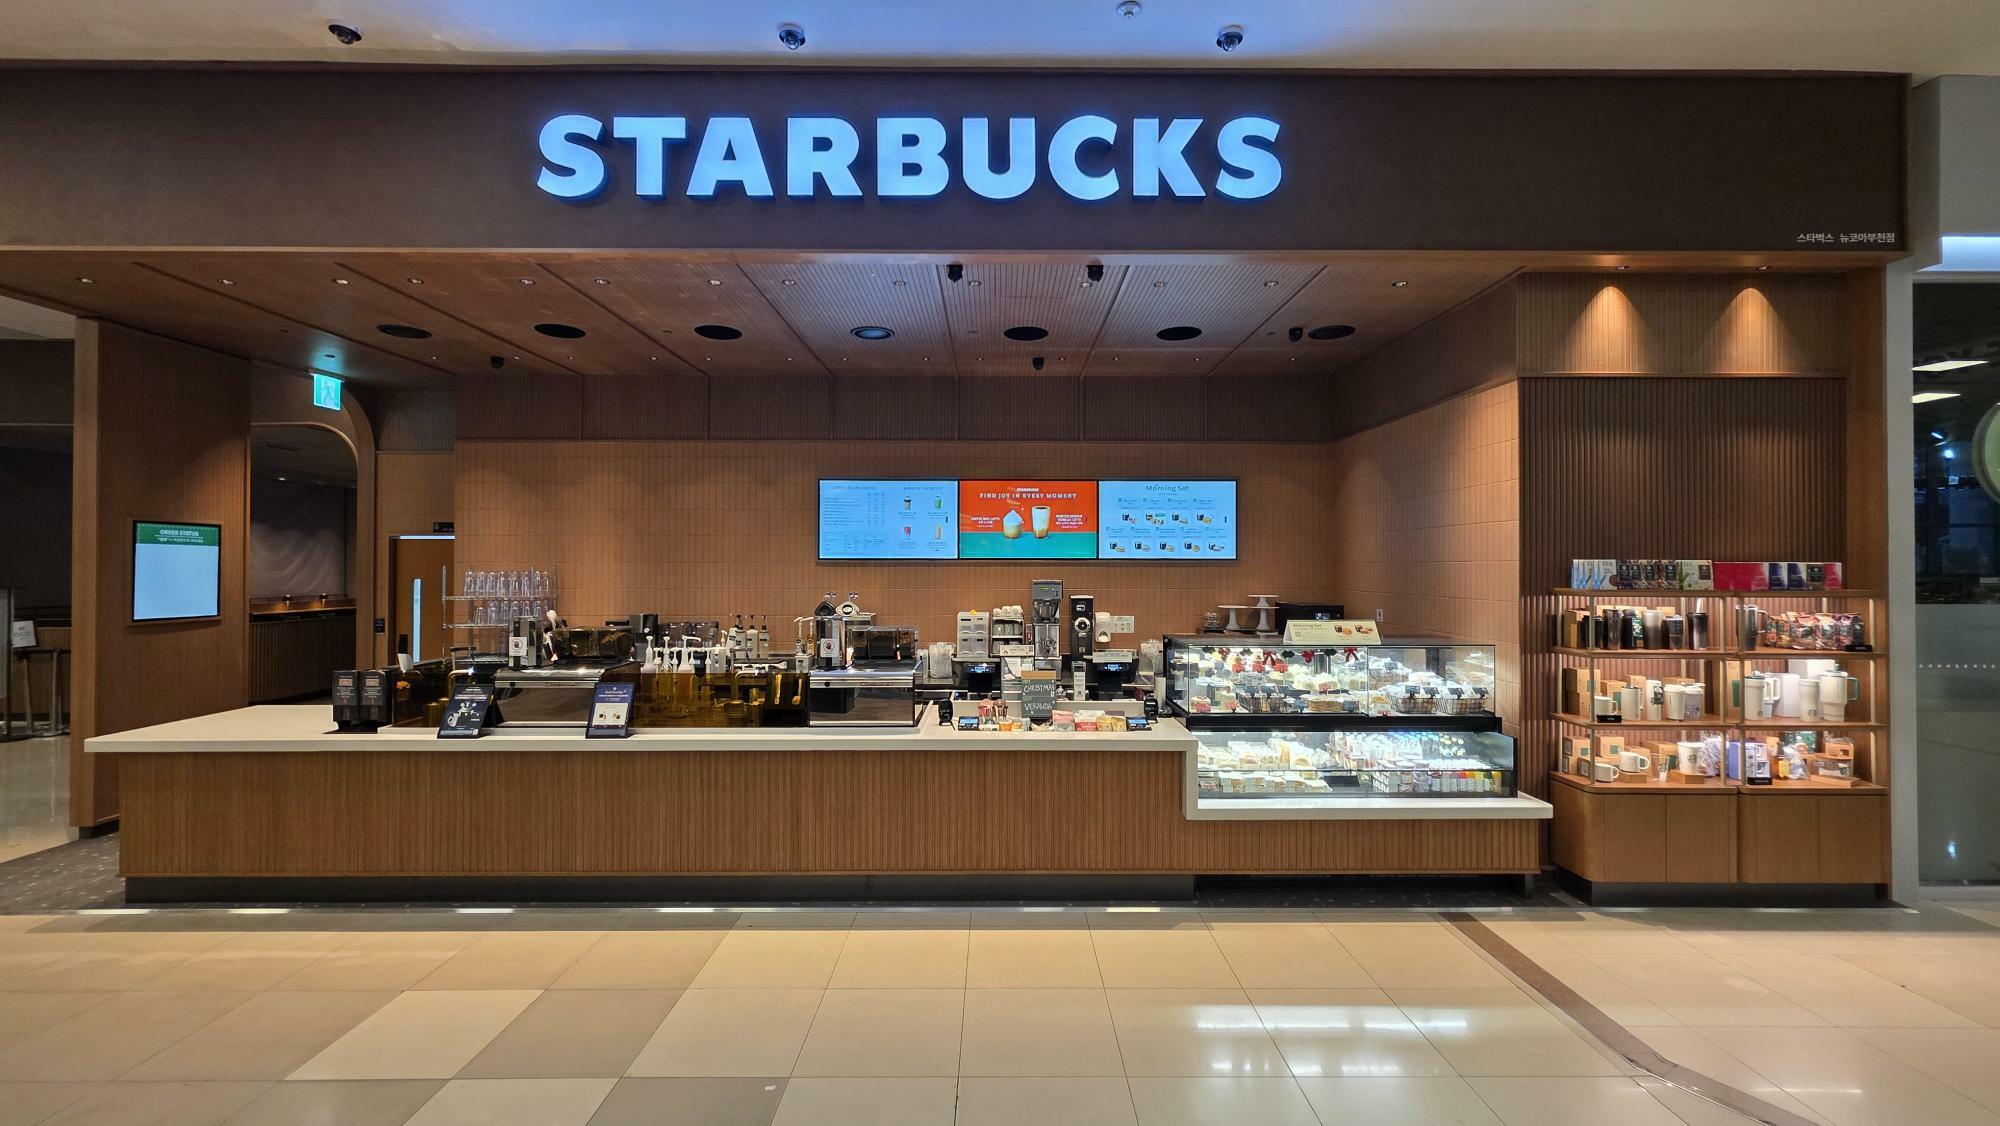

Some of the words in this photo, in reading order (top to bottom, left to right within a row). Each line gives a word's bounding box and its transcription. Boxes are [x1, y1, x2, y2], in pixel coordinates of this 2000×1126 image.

[536, 114, 1283, 200] STARBUCKS
[1797, 232, 1834, 243] 스타벅스
[1839, 232, 1895, 243] 뉴코아부천점
[1023, 684, 1055, 693] CHRISTMAS
[1024, 702, 1052, 711] VERANDA
